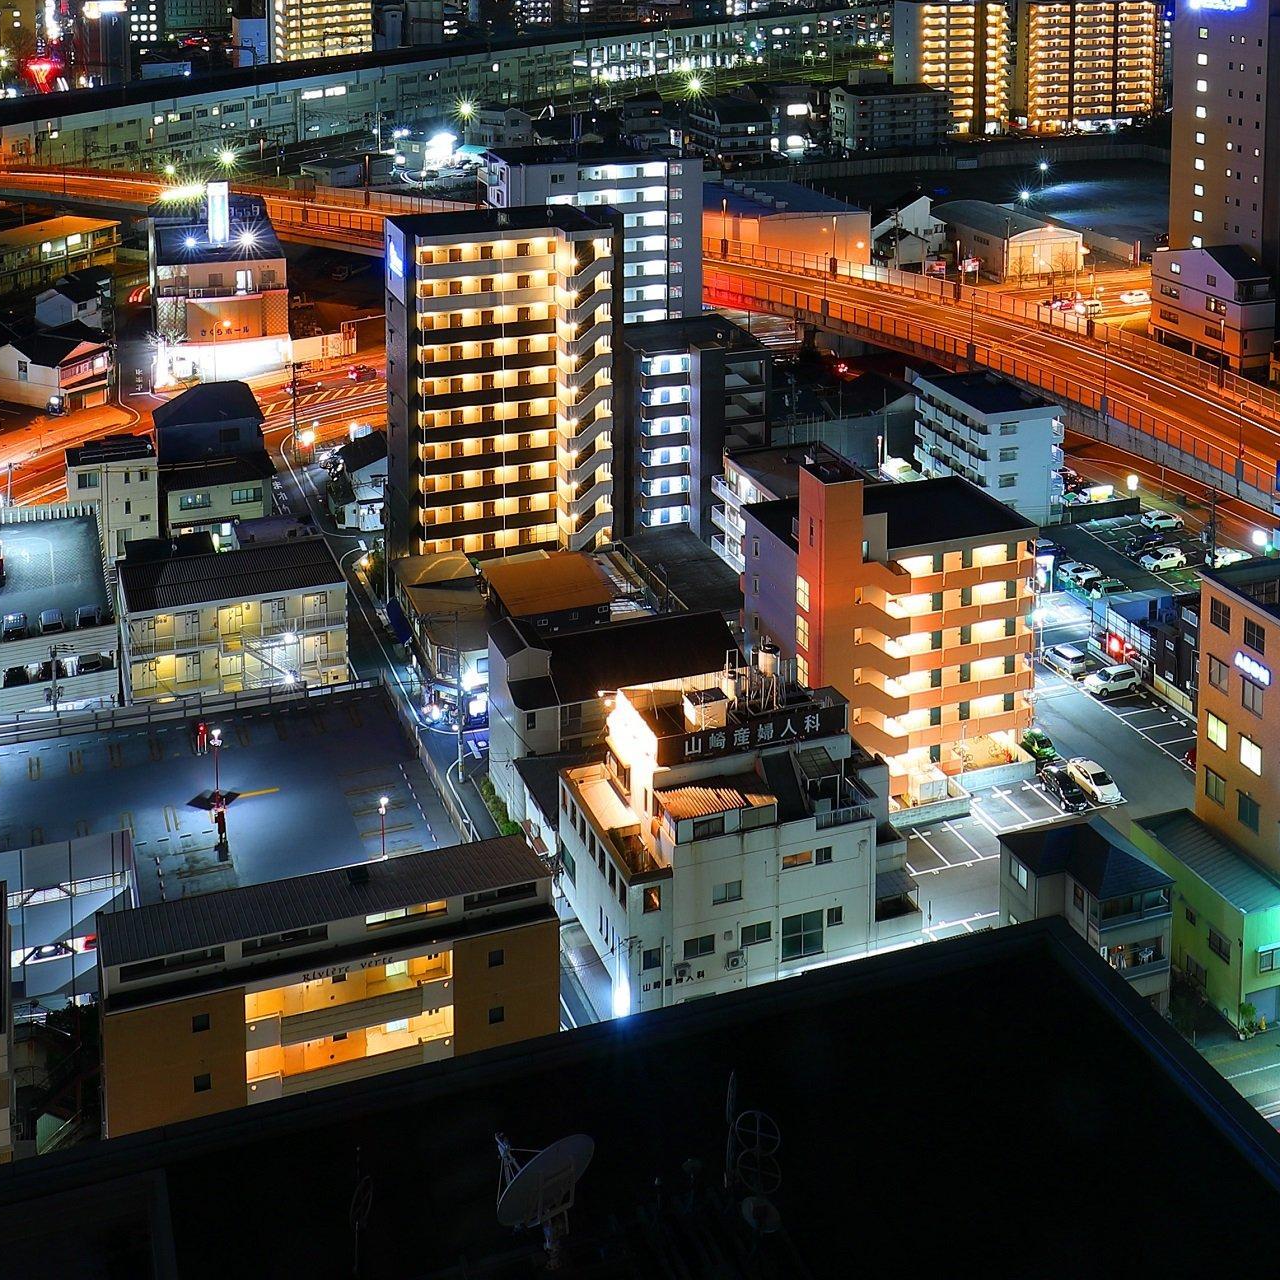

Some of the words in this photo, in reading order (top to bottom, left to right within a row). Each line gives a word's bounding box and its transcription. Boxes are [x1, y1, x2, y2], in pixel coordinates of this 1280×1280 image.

[200, 326, 250, 337] さくらホール
[684, 713, 821, 756] 山崎産婦人科
